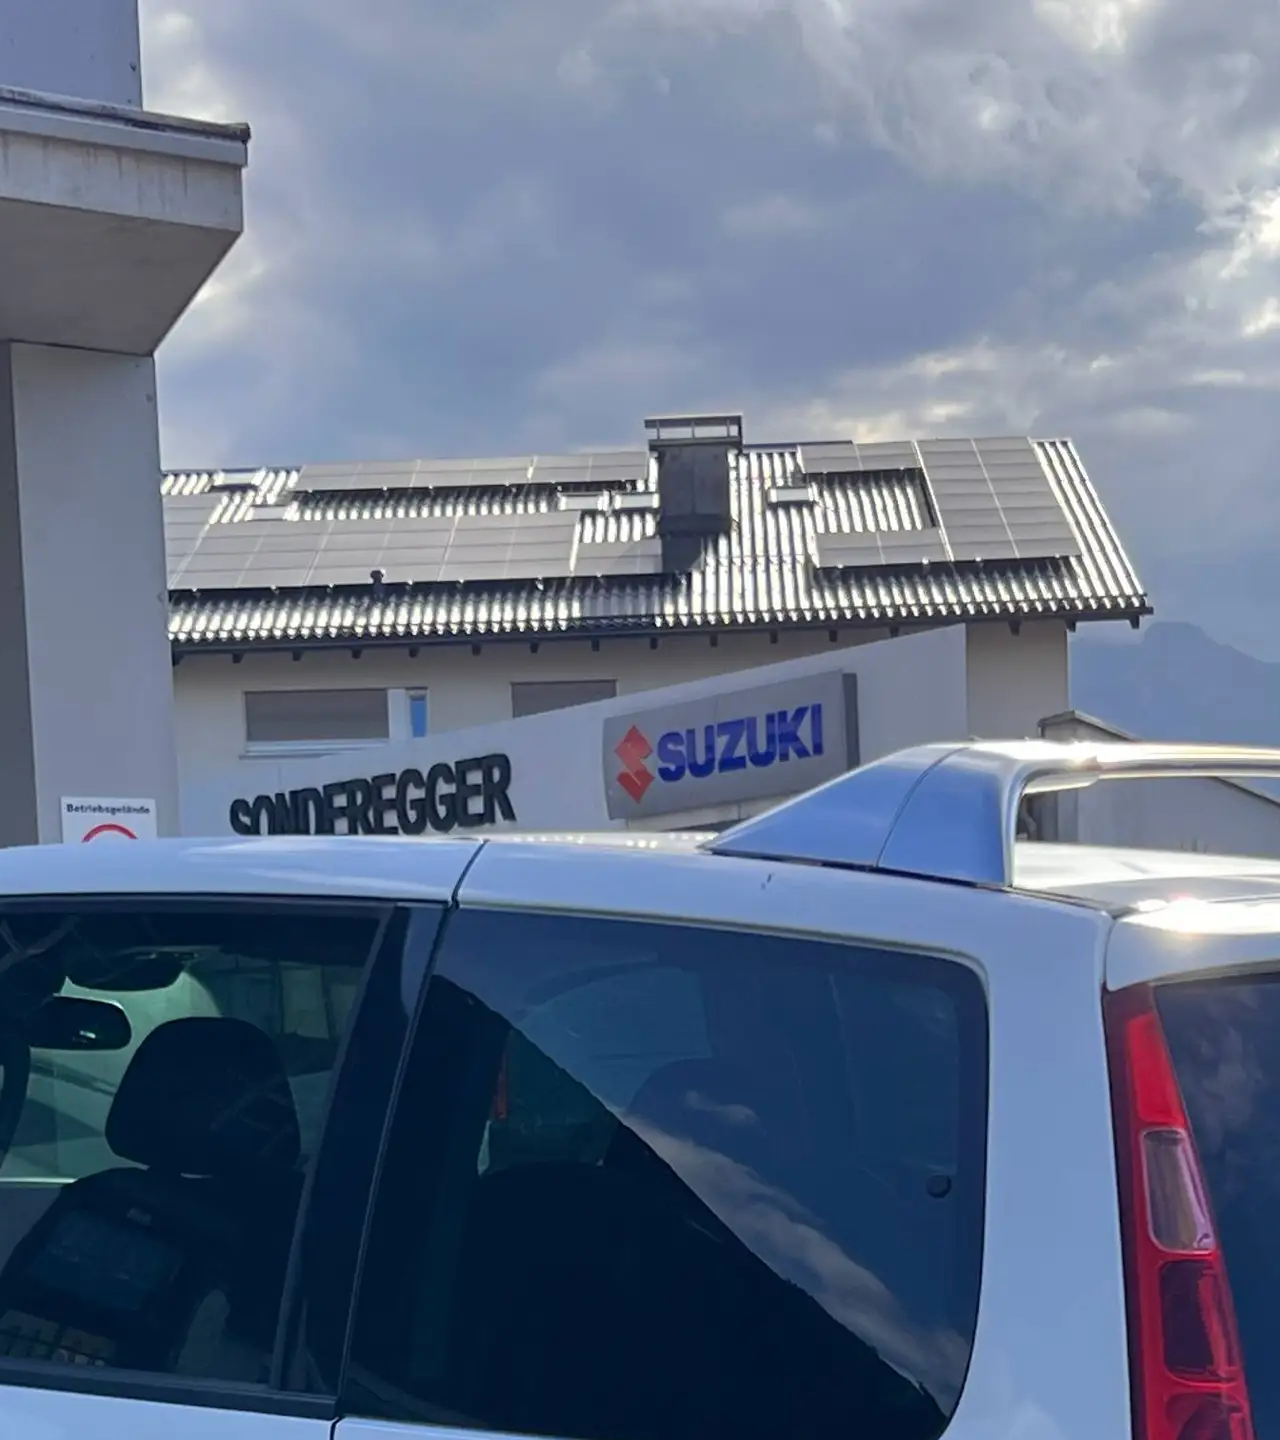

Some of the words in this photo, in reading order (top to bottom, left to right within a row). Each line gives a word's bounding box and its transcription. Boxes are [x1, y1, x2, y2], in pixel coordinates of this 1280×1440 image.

[657, 703, 825, 783] SUZUKI
[65, 803, 151, 816] Betriebsgelände
[229, 753, 517, 836] SONDEREGGER
